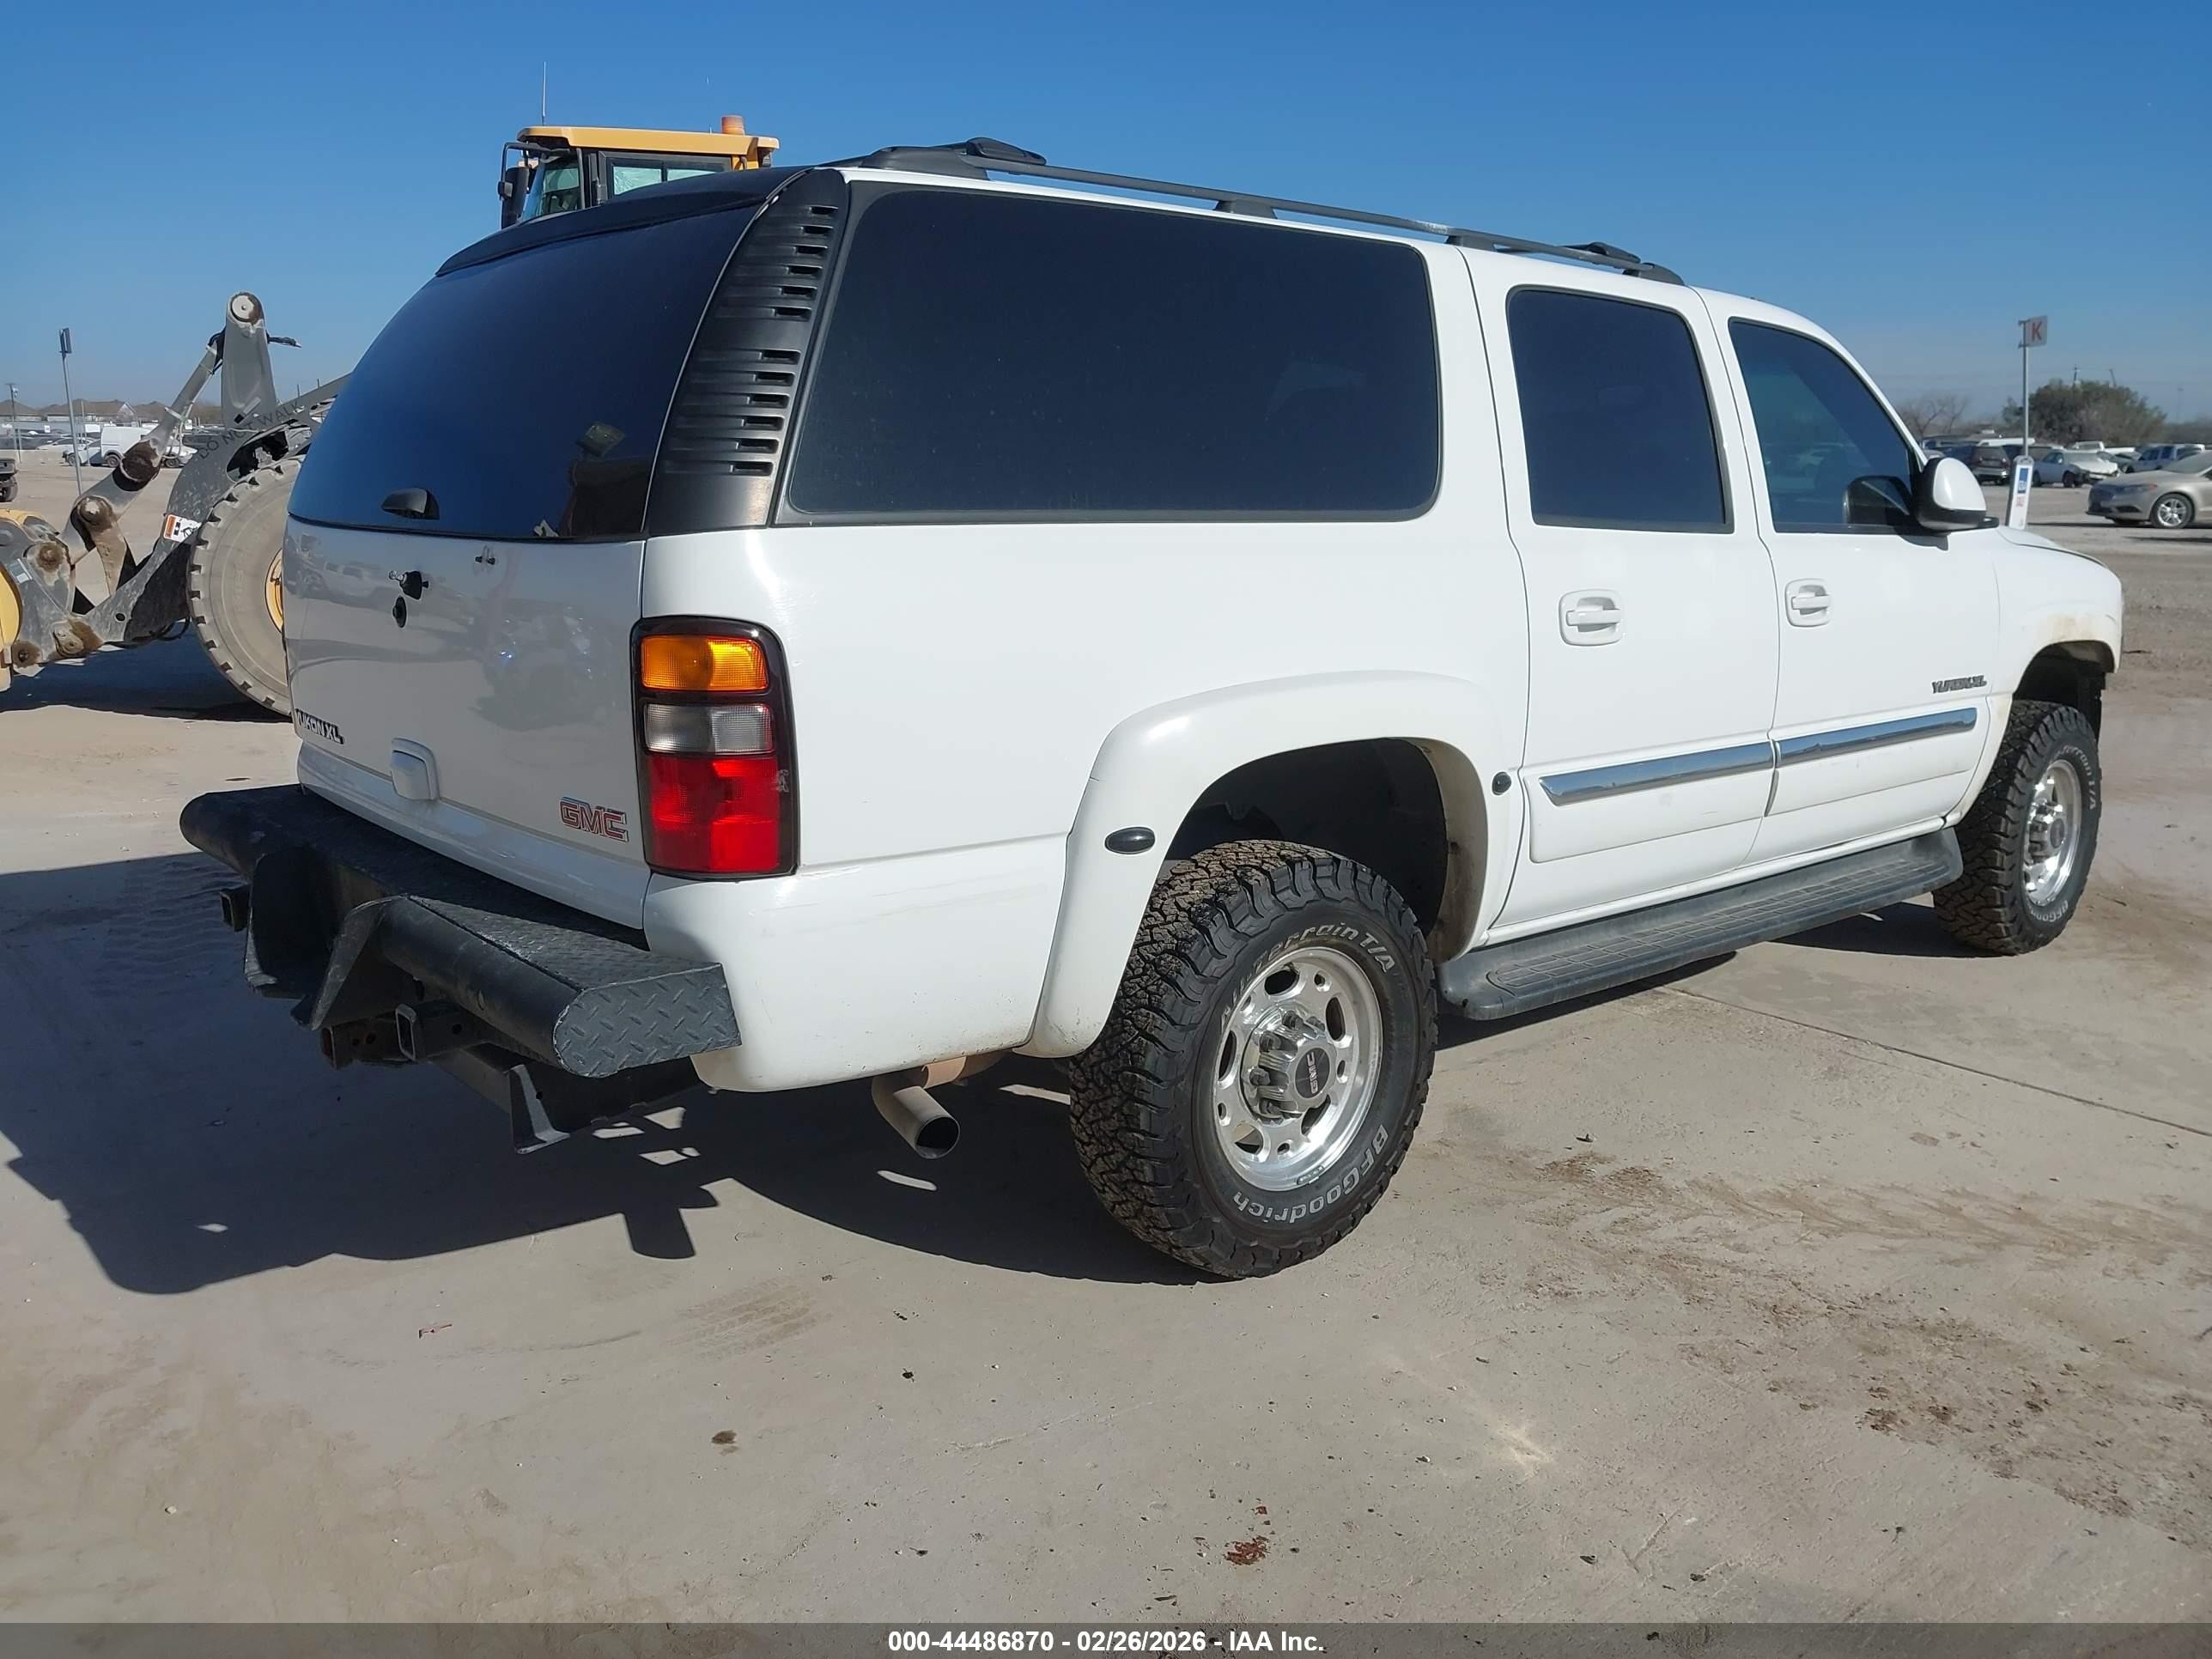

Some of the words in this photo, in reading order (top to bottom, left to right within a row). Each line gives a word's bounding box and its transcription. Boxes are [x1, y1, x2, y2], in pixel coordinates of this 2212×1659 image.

[2032, 321, 2043, 342] K
[198, 440, 219, 459] DO
[222, 422, 255, 445] NOT
[259, 401, 301, 427] WALK
[325, 721, 343, 744] XL
[560, 797, 629, 842] GMC
[1360, 933, 1395, 973] T/A
[1307, 1052, 1318, 1094] GMC
[1233, 1124, 1389, 1224] BFGoodrich
